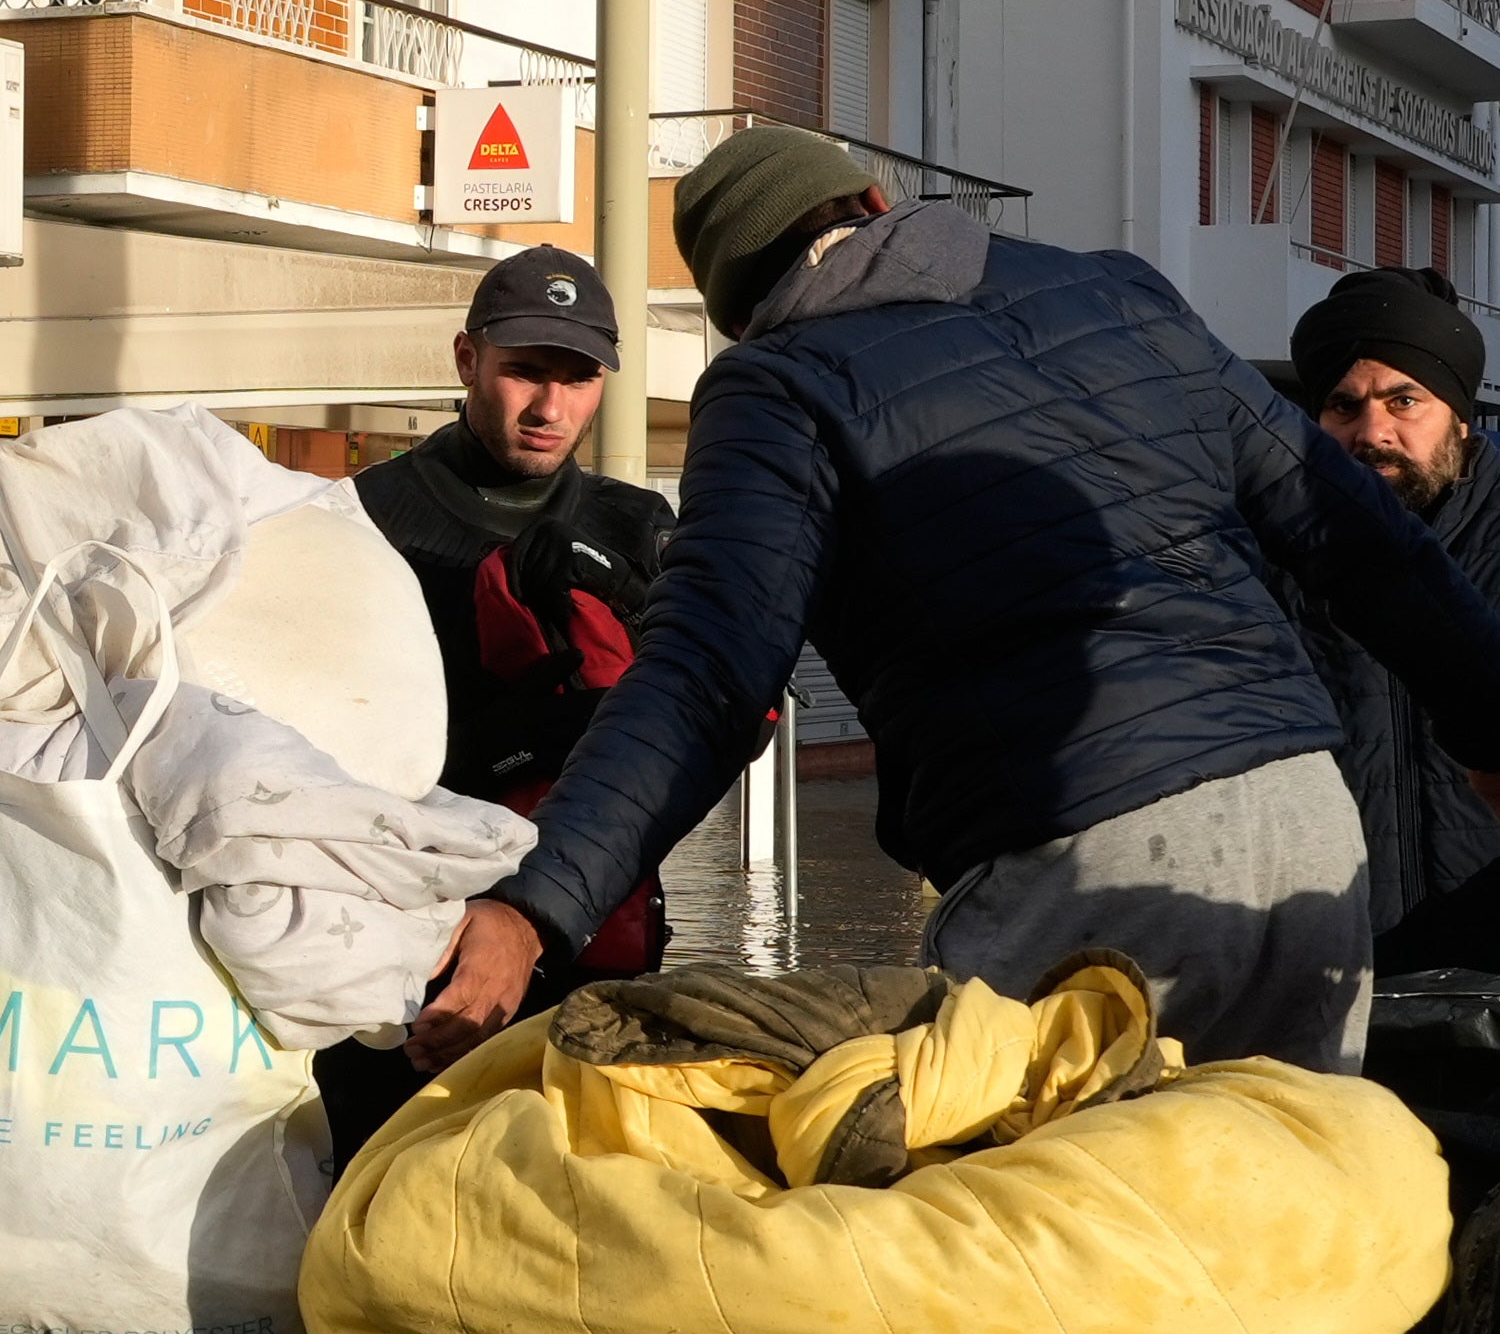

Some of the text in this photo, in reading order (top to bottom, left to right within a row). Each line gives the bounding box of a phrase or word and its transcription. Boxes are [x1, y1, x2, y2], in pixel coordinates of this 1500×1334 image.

[463, 182, 534, 194] PASTELARIA
[463, 197, 533, 211] CRESPO'S
[43, 1116, 213, 1150] FEELING
